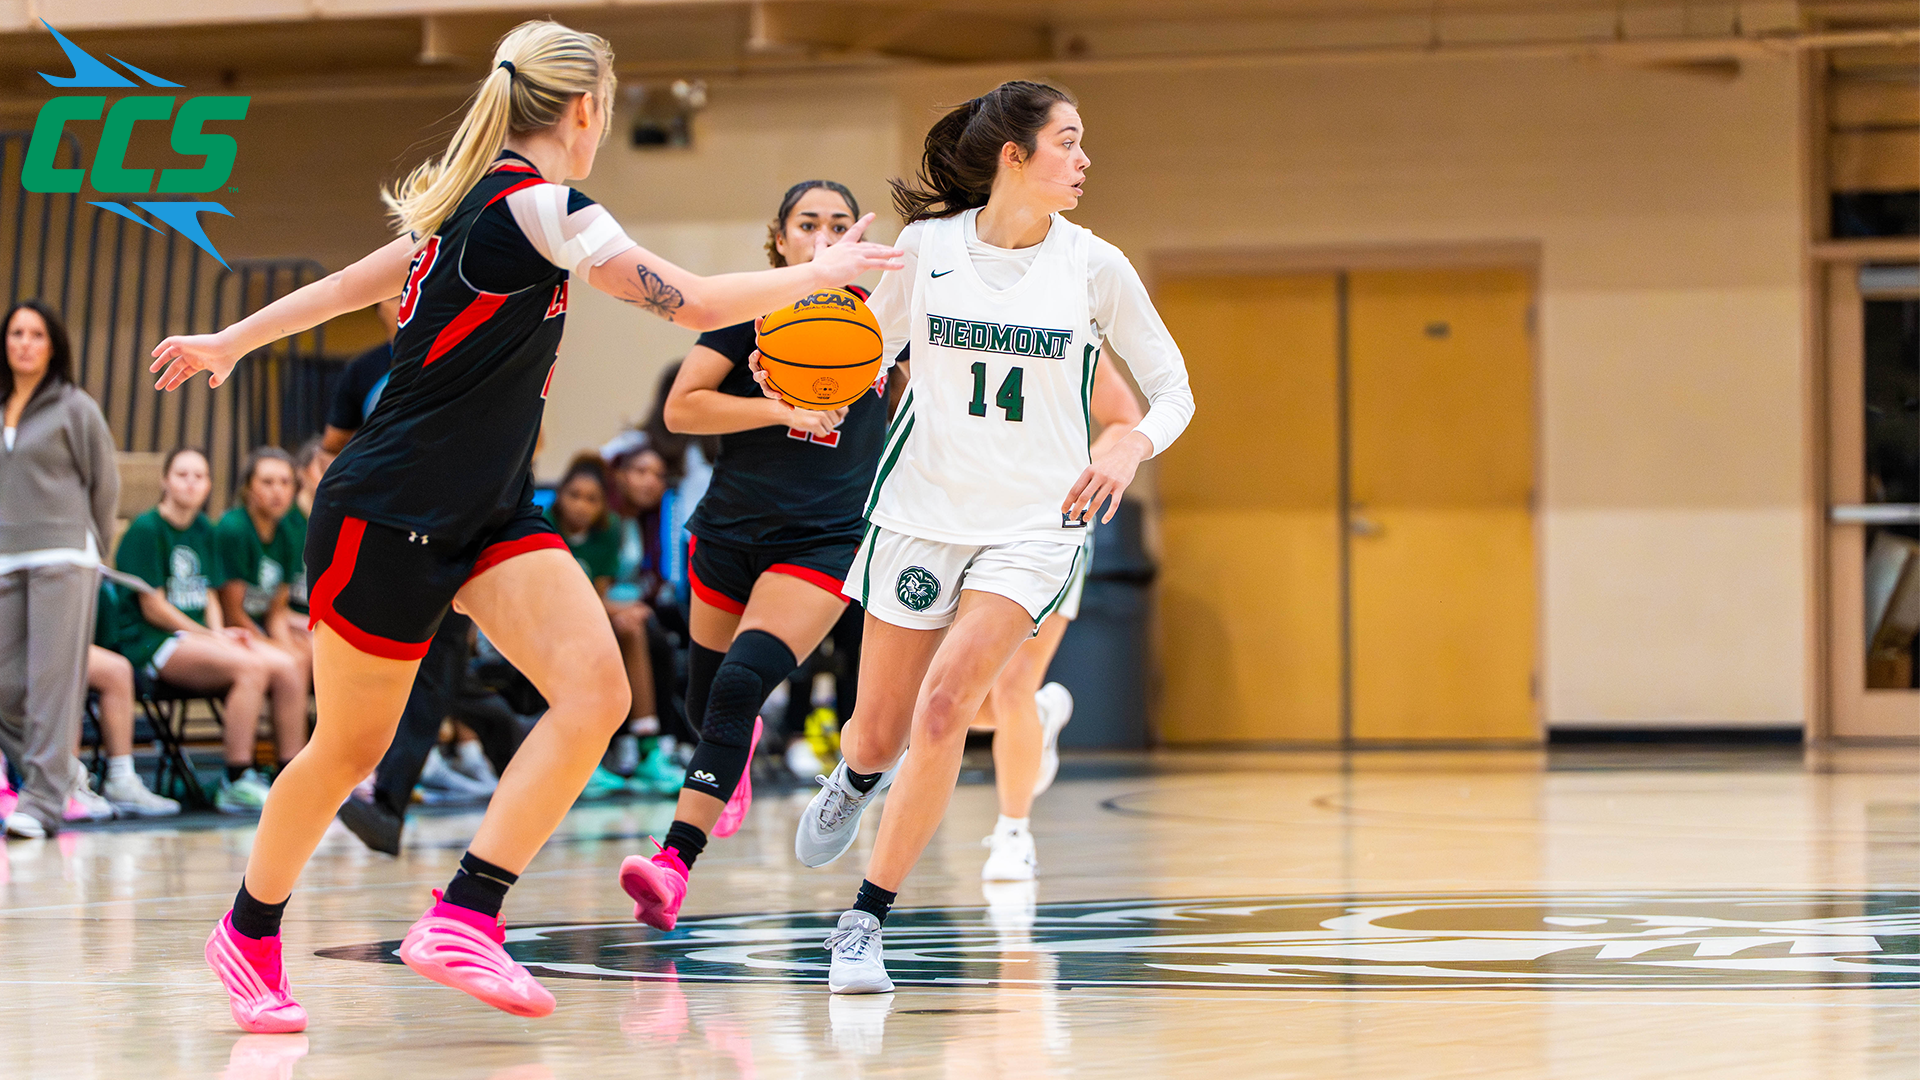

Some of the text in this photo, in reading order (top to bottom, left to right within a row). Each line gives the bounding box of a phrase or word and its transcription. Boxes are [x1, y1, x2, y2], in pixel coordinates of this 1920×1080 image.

[793, 293, 857, 311] NCAA
[927, 314, 1073, 359] PIEDMONT
[968, 361, 1025, 422] 14
